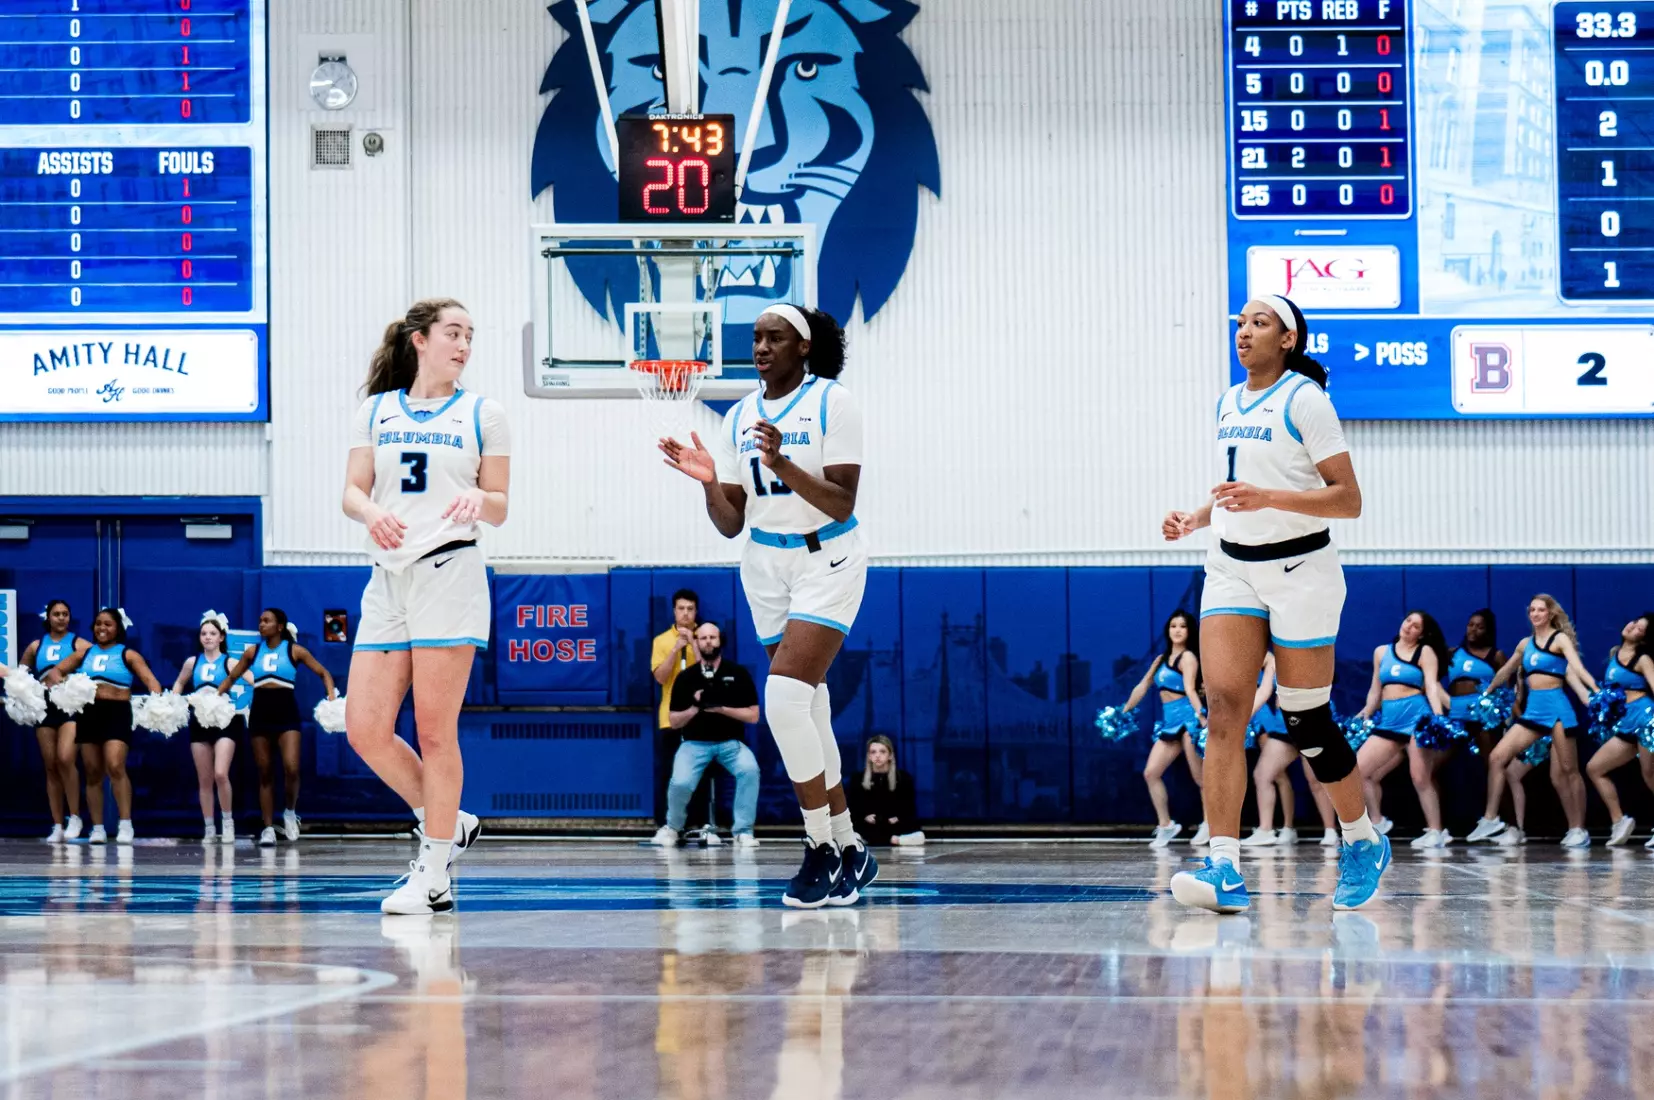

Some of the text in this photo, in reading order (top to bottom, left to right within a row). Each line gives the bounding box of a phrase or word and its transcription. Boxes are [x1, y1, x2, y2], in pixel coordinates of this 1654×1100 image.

[1277, 1, 1312, 20] PTS
[1322, 0, 1358, 19] REB
[1379, 0, 1390, 19] F
[70, 18, 190, 37] 0 0
[1576, 12, 1636, 38] 33.3
[70, 46, 190, 65] 0 1
[1245, 35, 1390, 56] 4 0 1 0
[70, 73, 190, 91] 0 1
[1246, 72, 1391, 93] 5 0 0 0
[1585, 60, 1629, 86] 0.0
[70, 99, 190, 118] 0 0
[1241, 109, 1391, 131] 15 0 0 1
[1599, 111, 1617, 137] 2
[653, 123, 723, 155] 7:43
[38, 152, 214, 175] ASSISTS FOULS
[1241, 147, 1392, 169] 21 2 0 1
[1602, 161, 1617, 186] 1
[71, 178, 190, 197] 0 1
[643, 160, 708, 214] 20
[1241, 184, 1394, 206] 25 0 0 0
[71, 206, 191, 225] 0 0
[1601, 211, 1620, 237] 0
[71, 233, 191, 252] 0 0
[71, 260, 191, 279] 0 0
[1280, 257, 1371, 296] JAG
[1604, 261, 1620, 287] 1
[71, 287, 192, 306] 0 0
[33, 342, 189, 376] AMITY HALL
[1376, 342, 1428, 366] POSS
[1470, 343, 1608, 393] B 2
[400, 451, 428, 493] 3
[1226, 445, 1238, 482] 1
[517, 604, 588, 628] FIRE
[46, 645, 61, 661] C
[508, 639, 597, 662] HOSE
[92, 654, 109, 672] C
[202, 663, 216, 682] C
[262, 653, 278, 672] C
